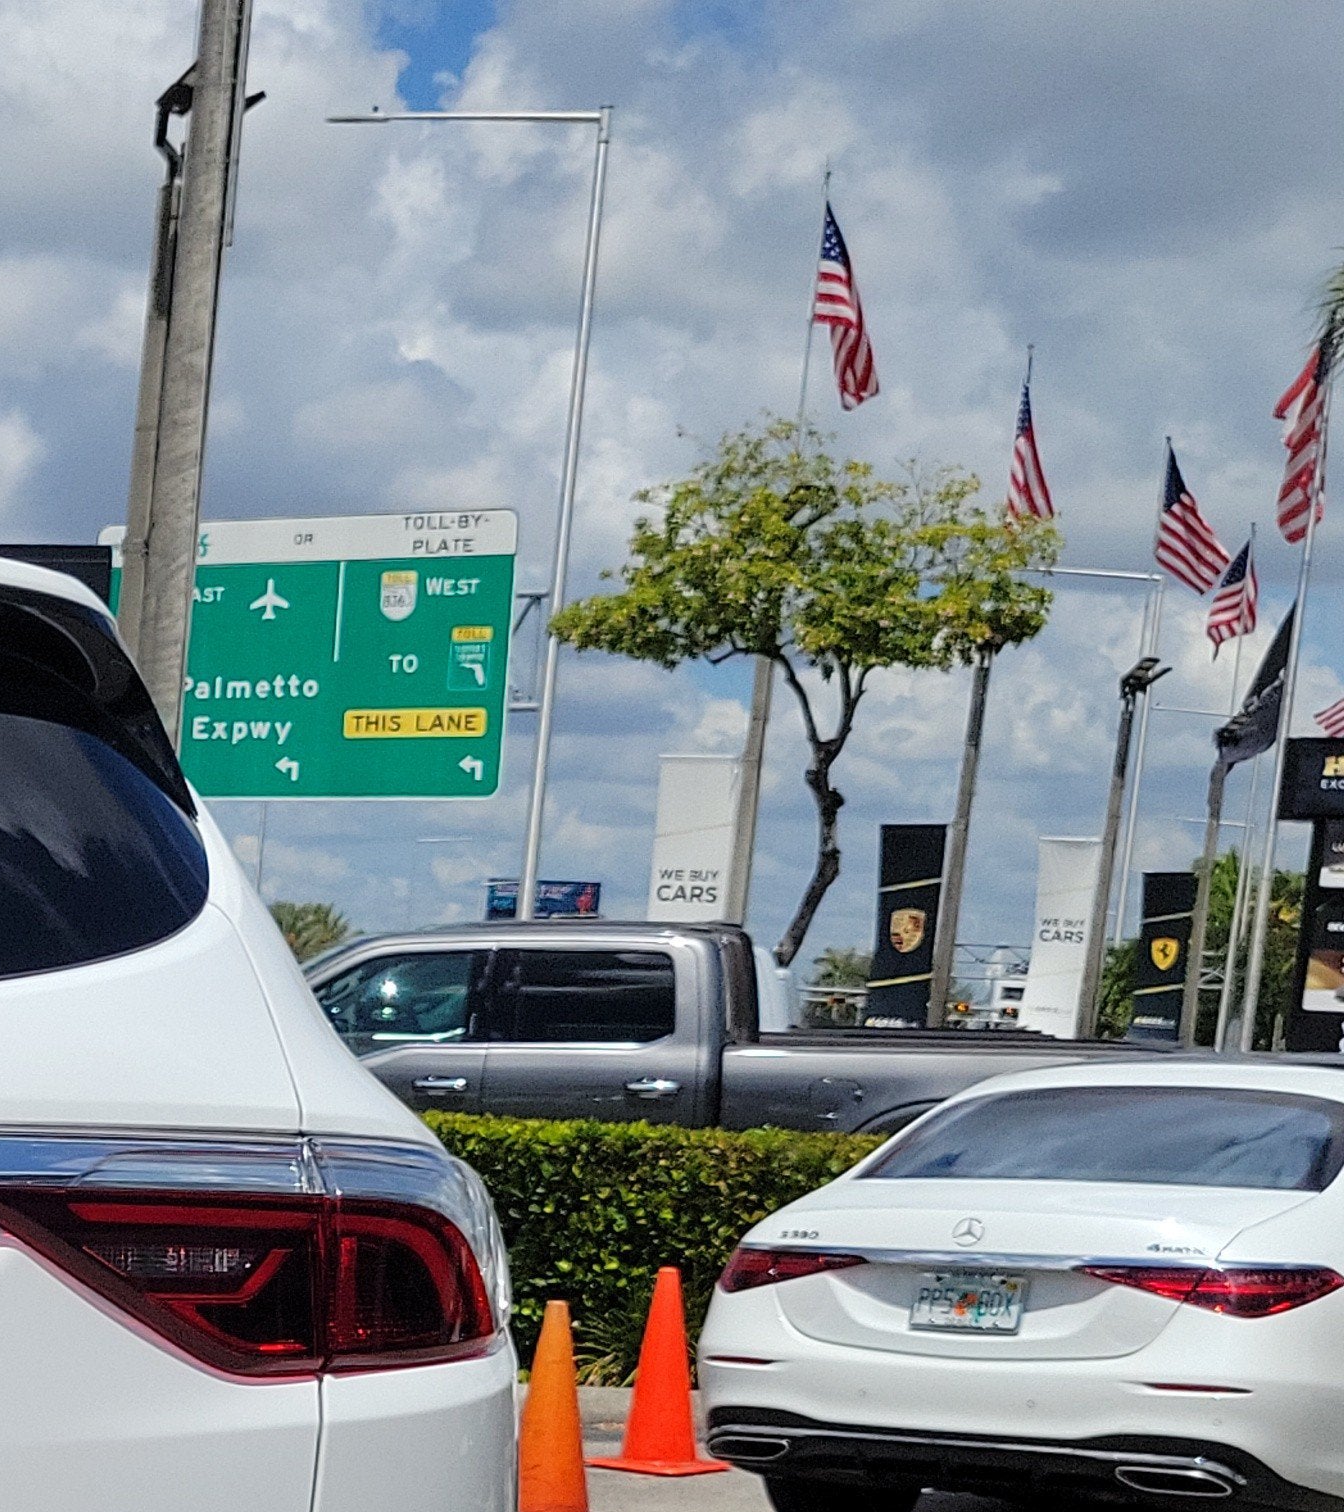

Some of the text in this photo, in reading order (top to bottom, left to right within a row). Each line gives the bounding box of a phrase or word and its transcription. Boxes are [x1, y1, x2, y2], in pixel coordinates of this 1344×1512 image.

[293, 533, 314, 545] OR
[412, 538, 474, 554] PLATE
[192, 586, 225, 603] AST
[425, 577, 481, 596] WEST
[388, 654, 419, 674] TO
[191, 716, 292, 746] Expwy
[353, 714, 478, 732] THIS LANE
[658, 869, 719, 882] WE BUY
[656, 885, 718, 903] CARS
[1039, 929, 1084, 944] CARS
